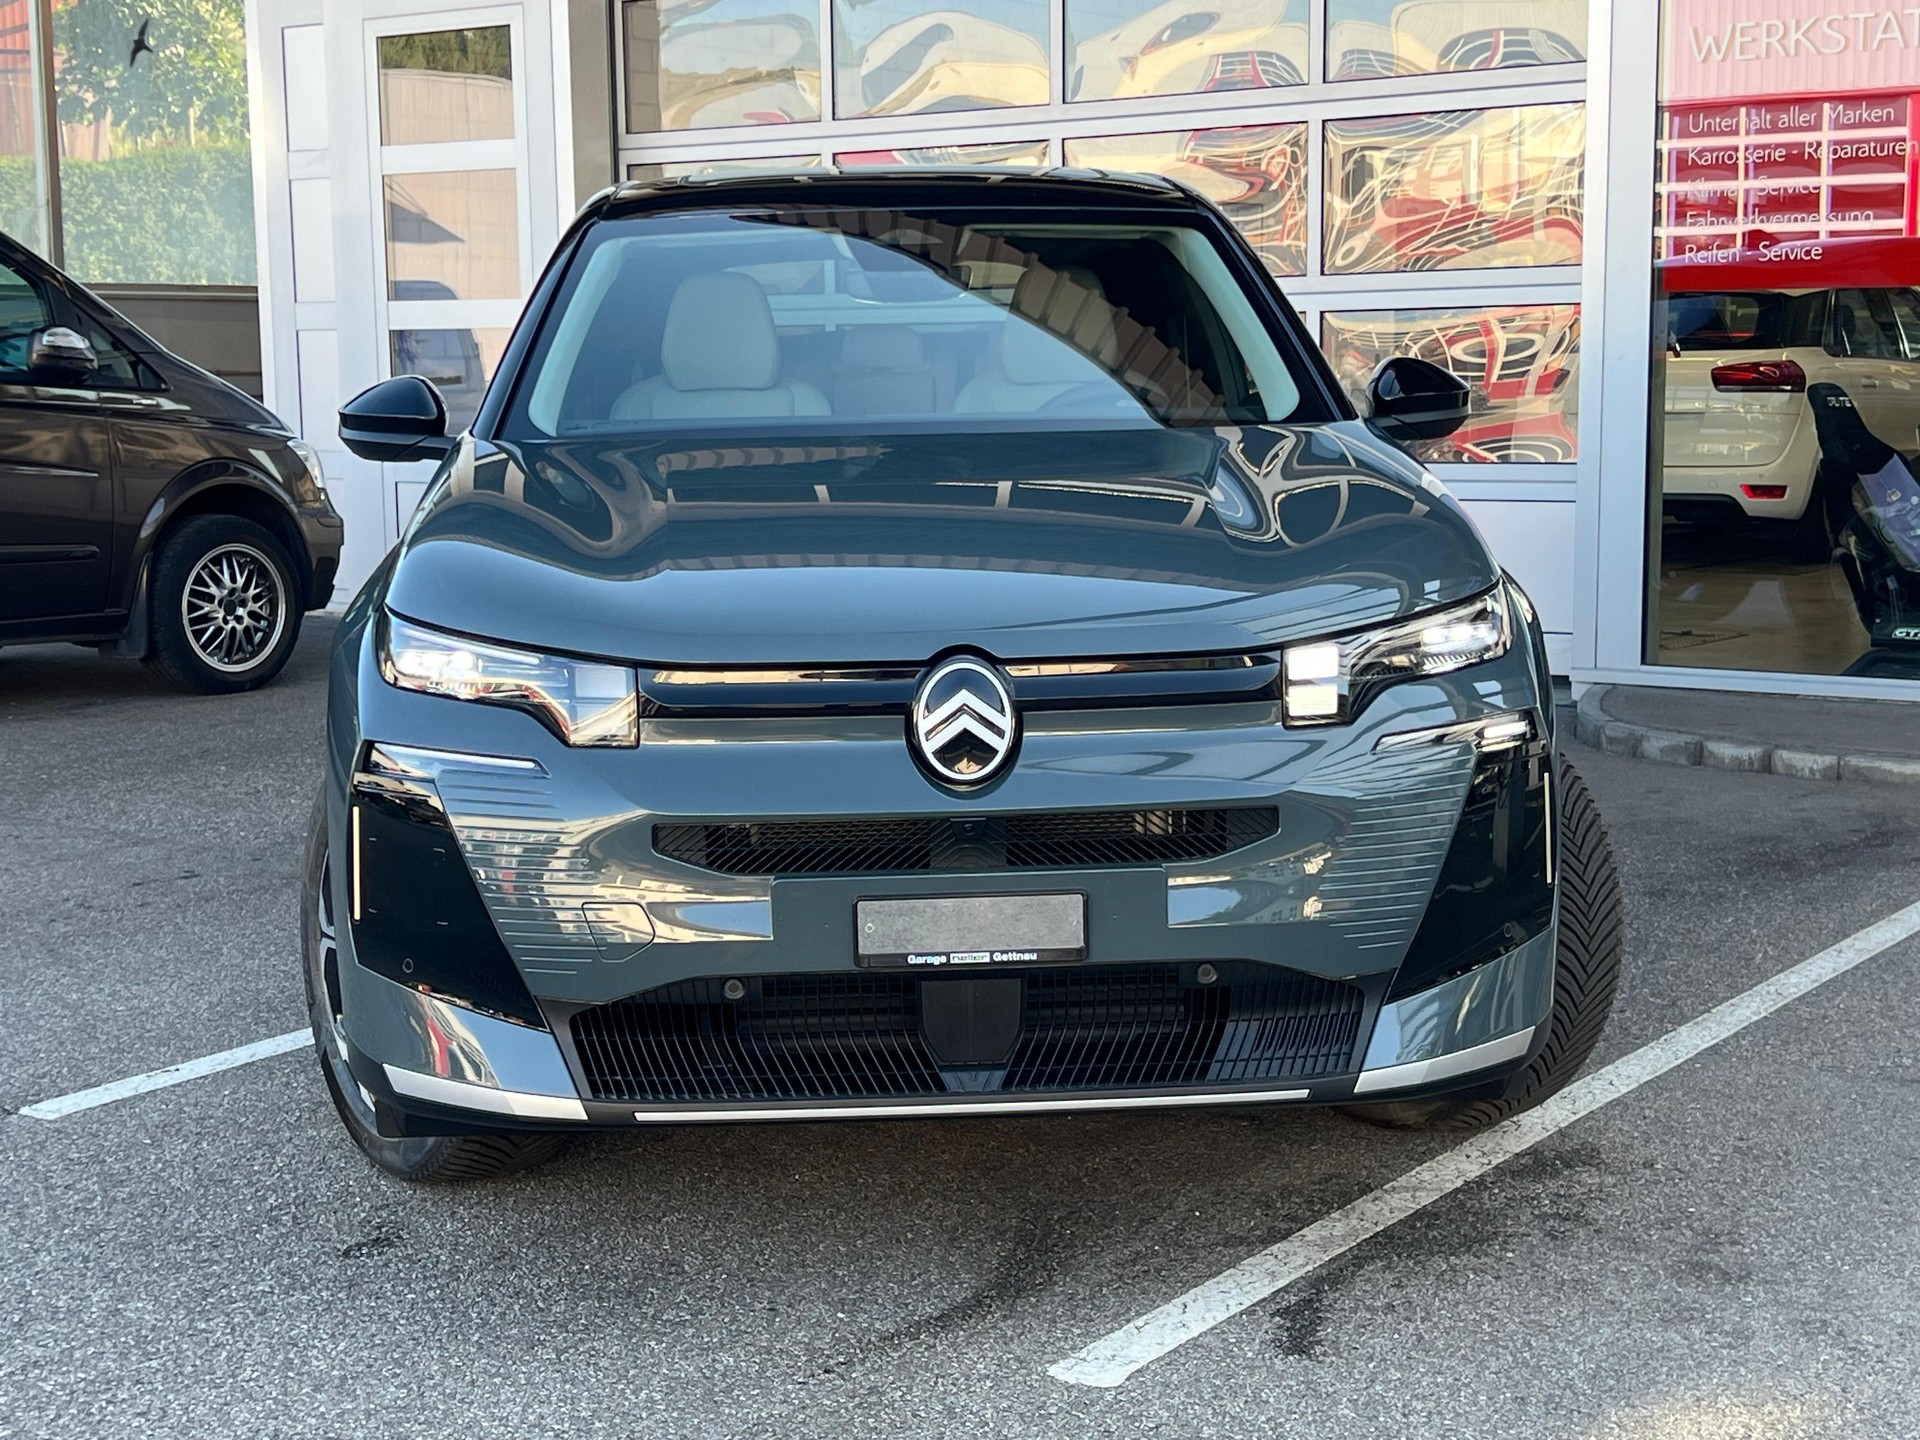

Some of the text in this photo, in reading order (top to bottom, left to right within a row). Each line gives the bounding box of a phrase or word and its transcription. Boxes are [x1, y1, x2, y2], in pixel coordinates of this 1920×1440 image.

[1689, 8, 1920, 63] WERKSTAT
[1778, 106, 1817, 128] aller
[1826, 101, 1895, 125] Marken
[1686, 208, 1874, 231] Fahrwerkvermesung
[1685, 242, 1740, 264] Reifen
[1758, 241, 1823, 262] Service
[907, 954, 947, 965] Garage
[993, 952, 1037, 961] Gettnau
